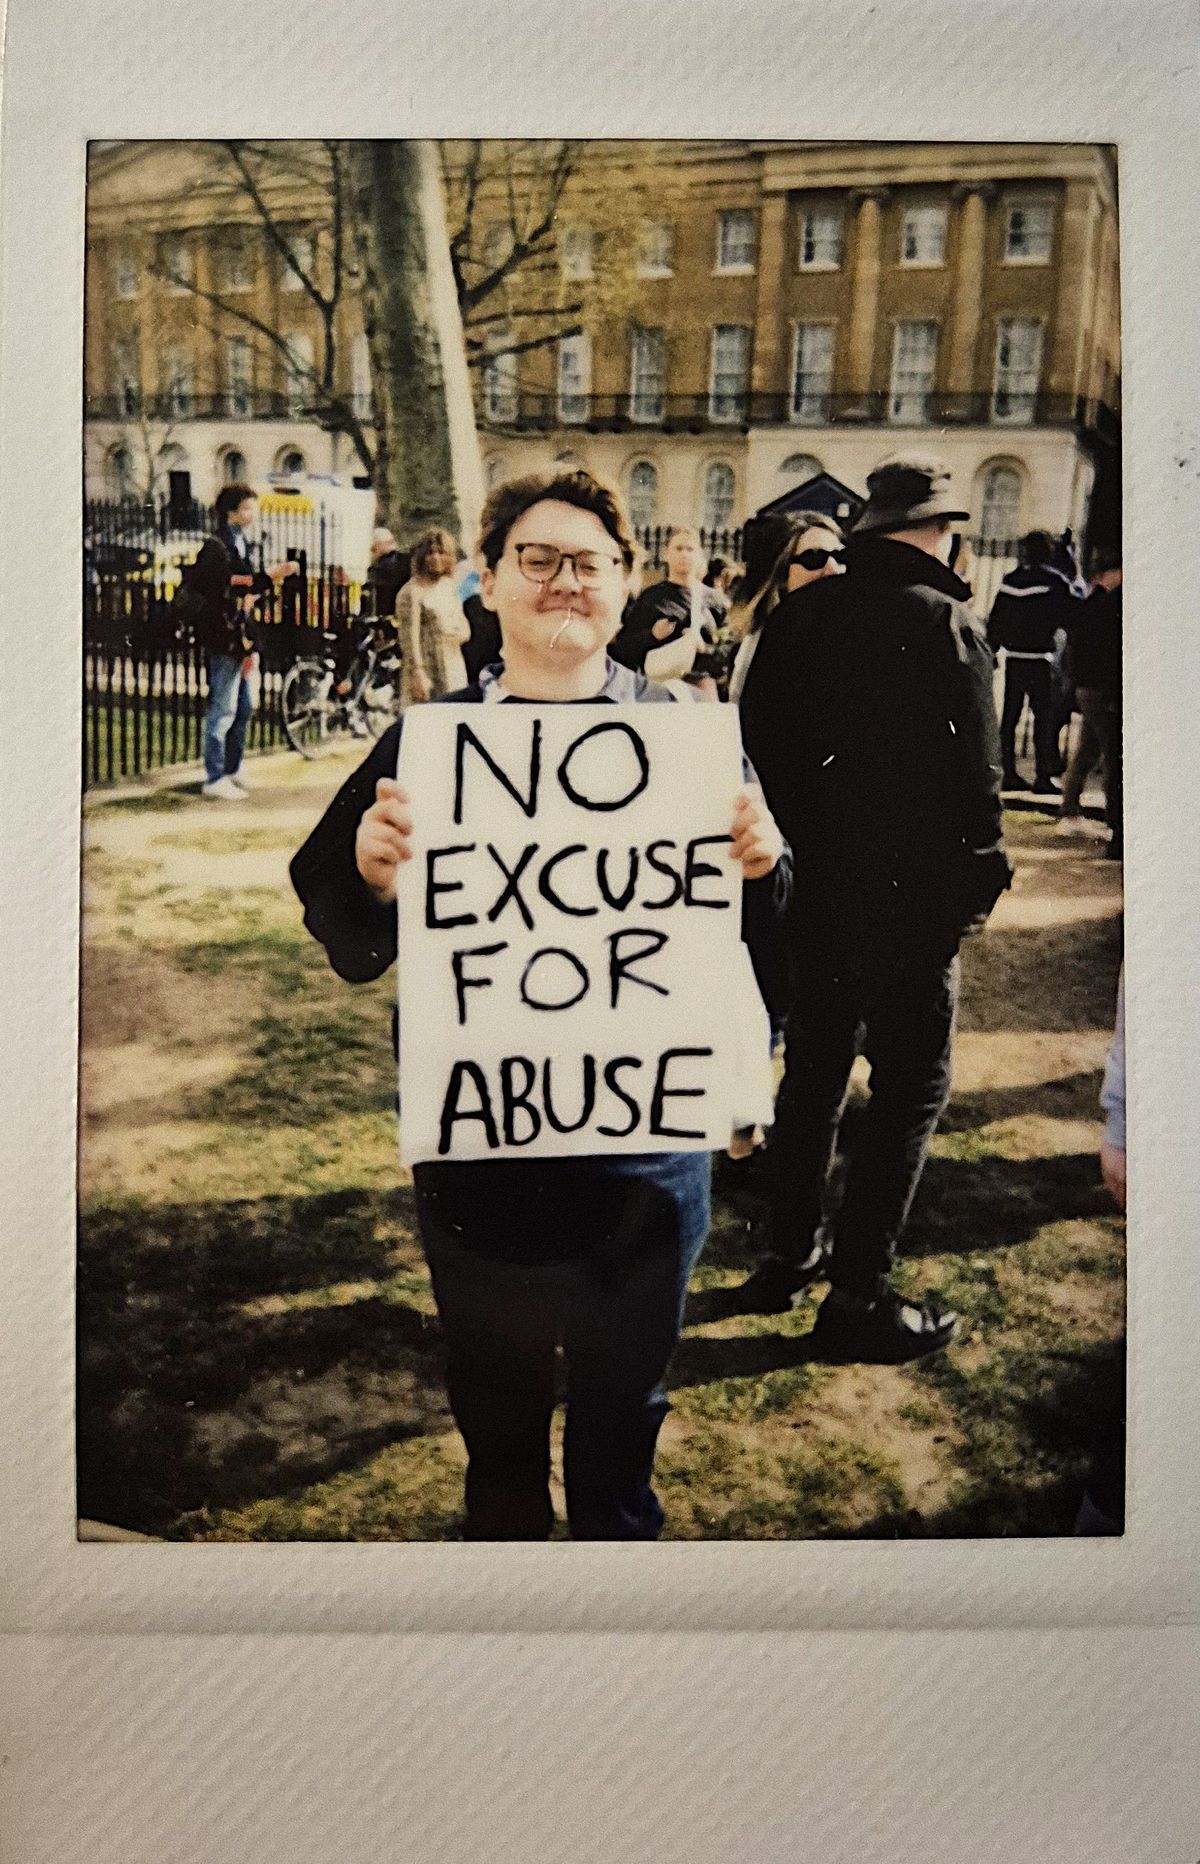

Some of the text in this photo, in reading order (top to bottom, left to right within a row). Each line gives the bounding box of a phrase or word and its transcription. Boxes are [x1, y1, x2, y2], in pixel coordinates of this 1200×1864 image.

[454, 719, 649, 824] NO
[426, 835, 735, 929] EXCUSE
[452, 929, 669, 1025] FOR
[438, 1048, 712, 1154] ABUSE
